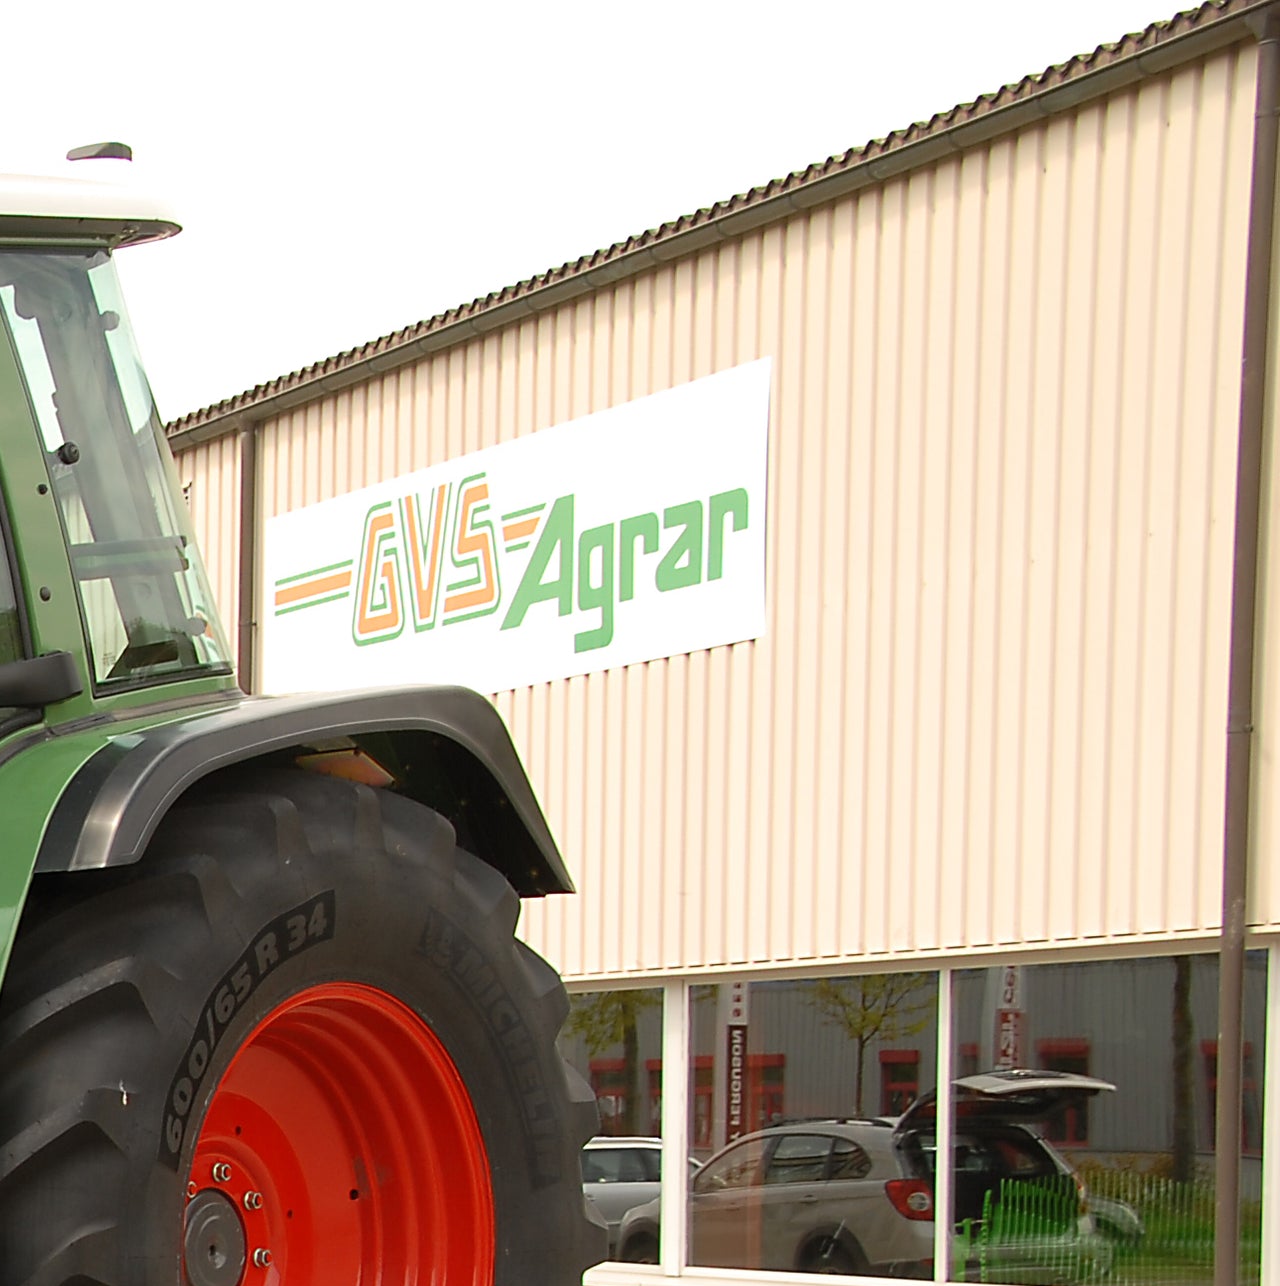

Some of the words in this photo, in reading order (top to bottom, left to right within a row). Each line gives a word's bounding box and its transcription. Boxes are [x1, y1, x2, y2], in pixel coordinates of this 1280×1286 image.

[352, 472, 502, 647] GVS
[501, 487, 749, 654] Agrar
[166, 962, 252, 1153] 600/65
[255, 932, 279, 975] R
[287, 902, 328, 951] 34
